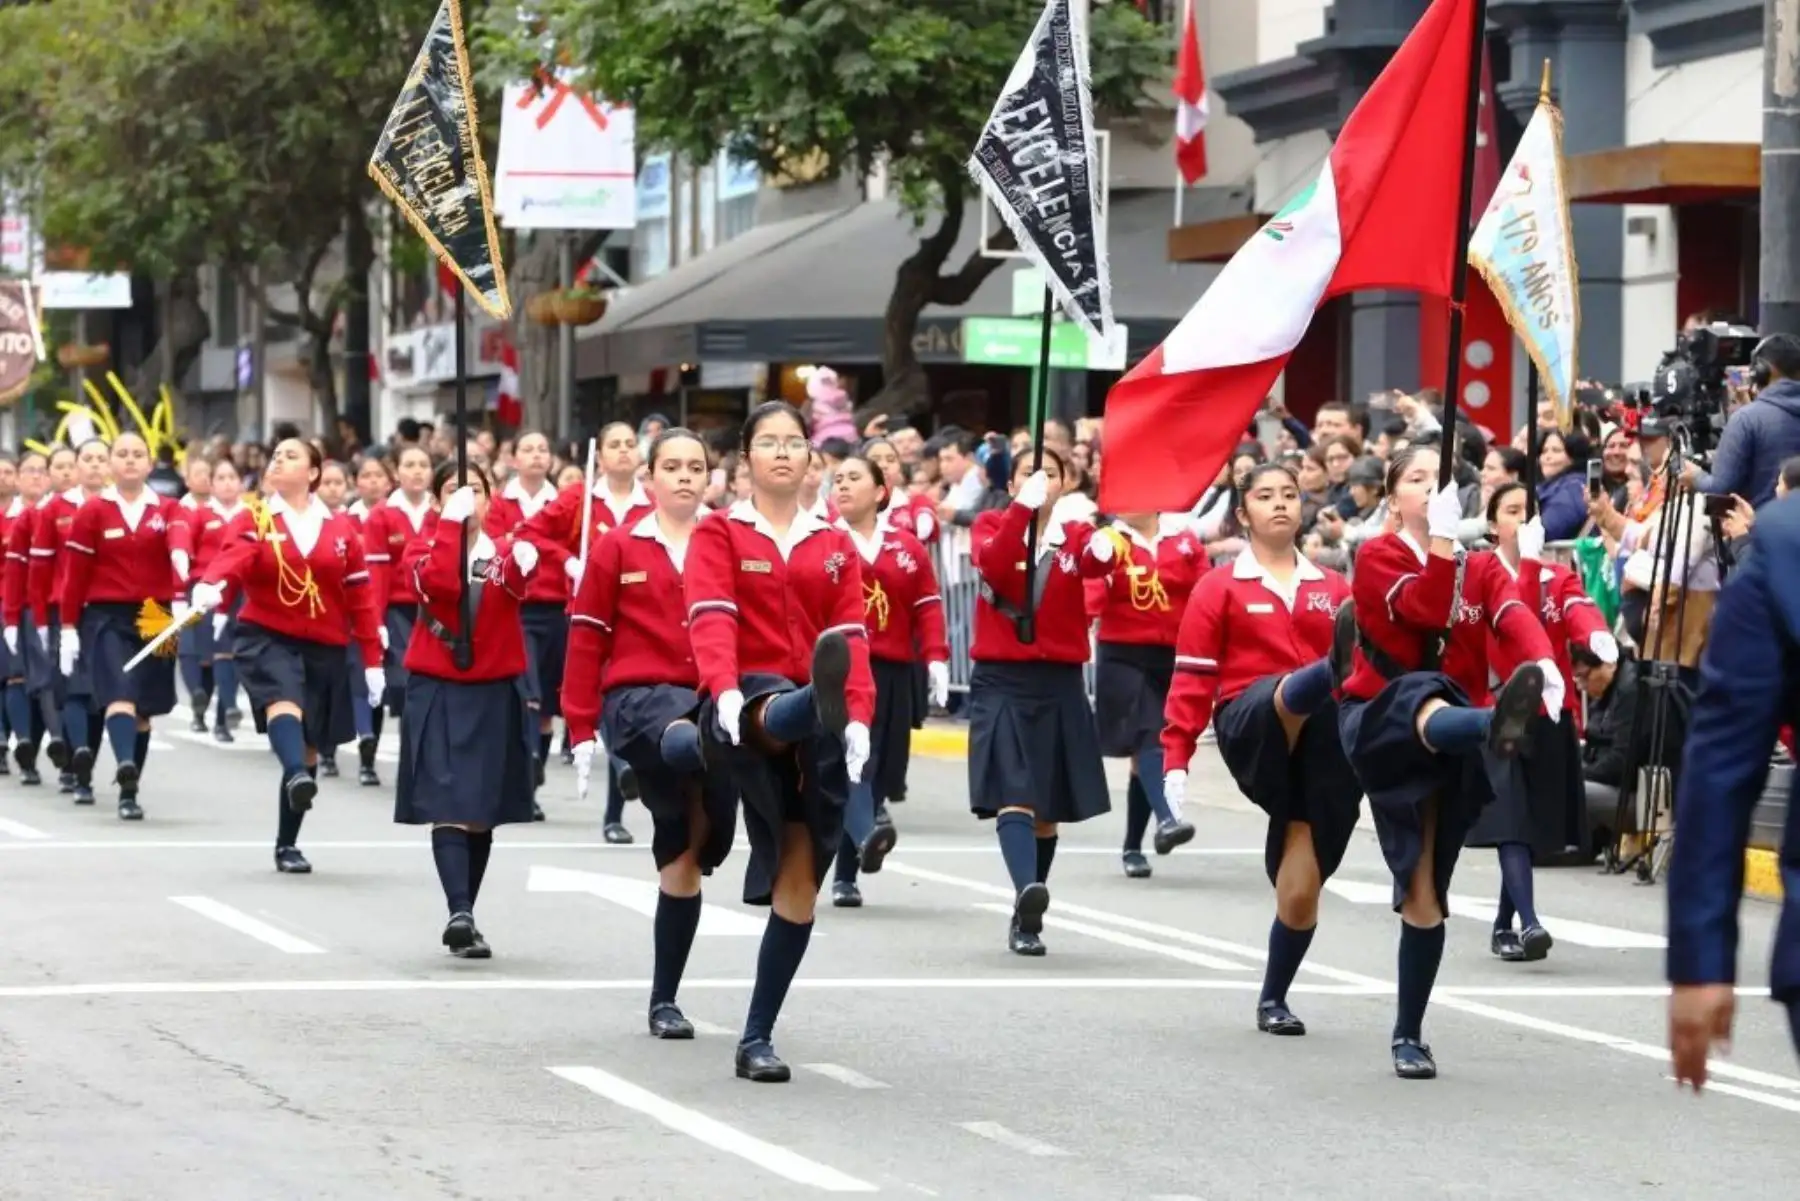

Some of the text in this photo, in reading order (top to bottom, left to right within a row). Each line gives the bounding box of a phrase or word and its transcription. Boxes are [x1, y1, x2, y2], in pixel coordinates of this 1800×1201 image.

[457, 119, 473, 154] MARIA
[402, 139, 470, 237] EXCELENCIA
[999, 97, 1083, 278] EXCELENCIA
[1501, 209, 1538, 255] 179
[1521, 260, 1560, 331] AÑOS
[1666, 370, 1678, 394] 5
